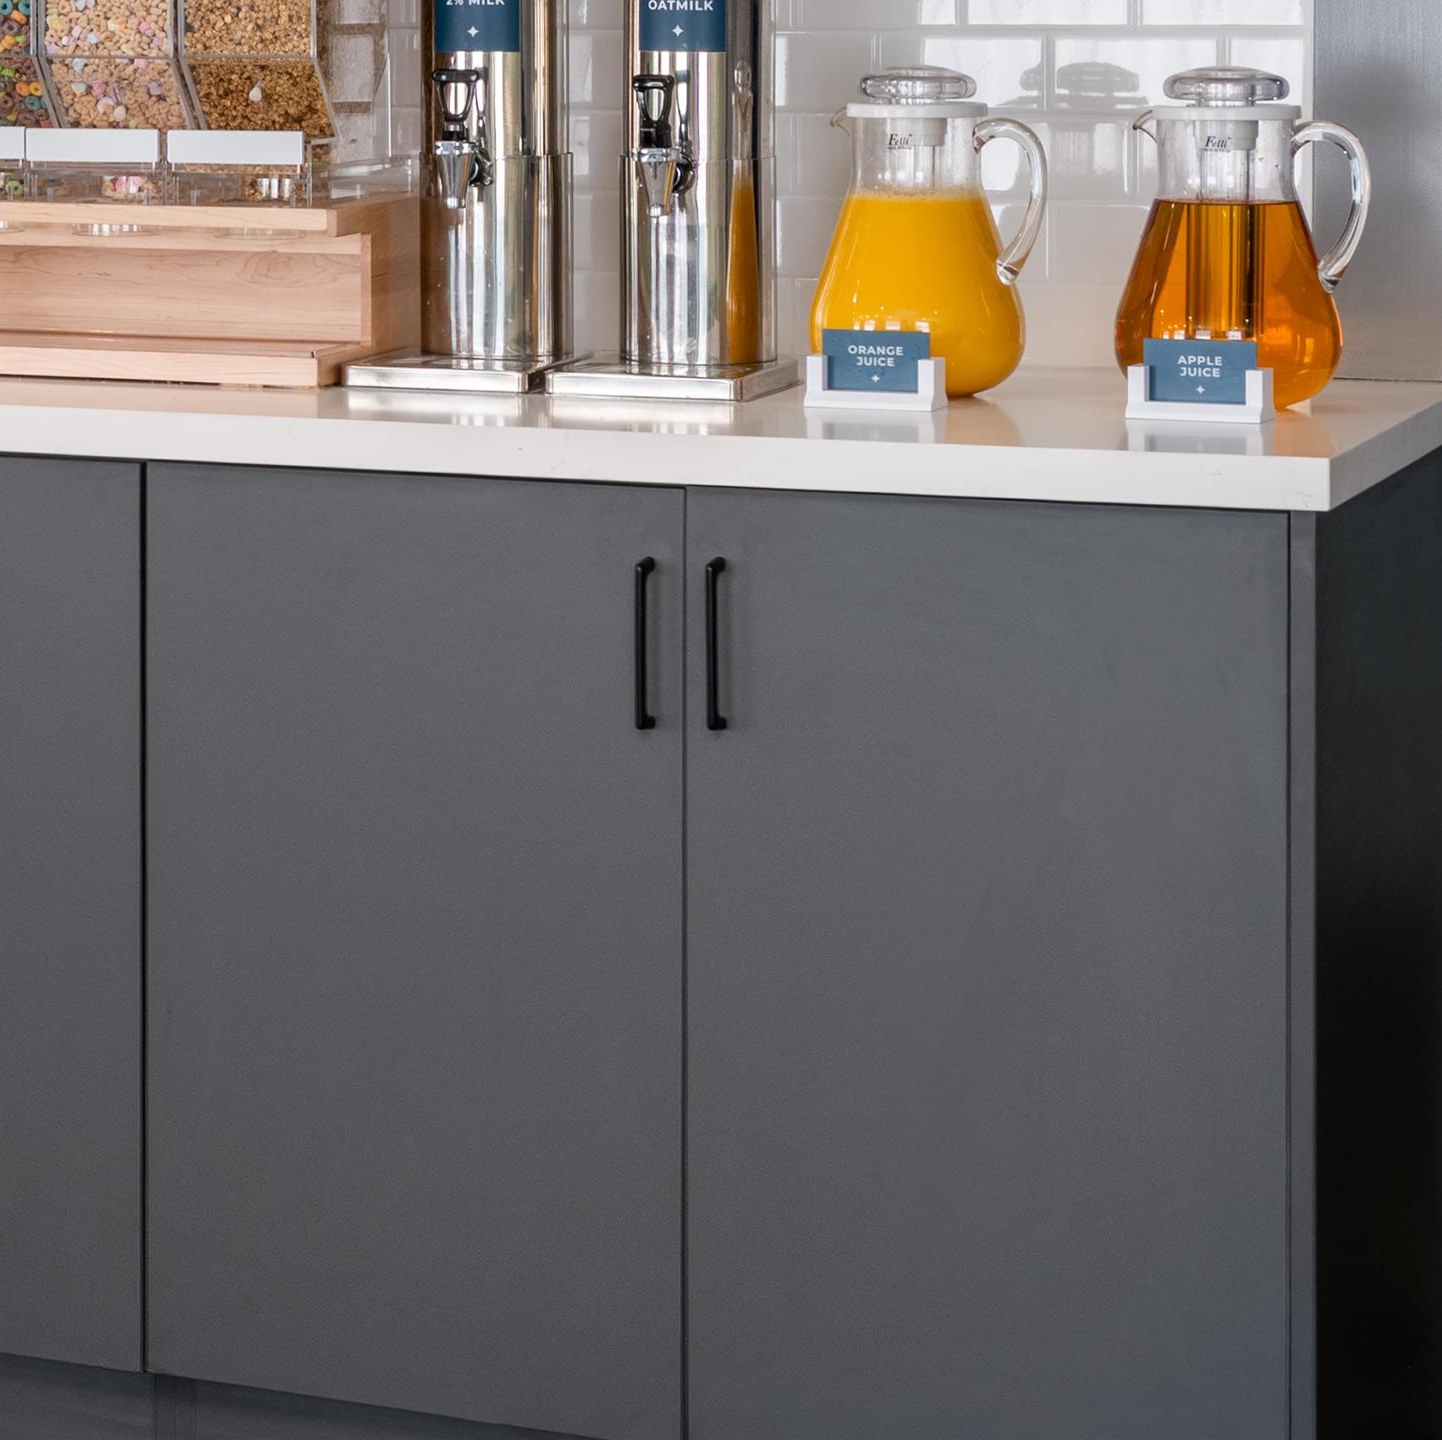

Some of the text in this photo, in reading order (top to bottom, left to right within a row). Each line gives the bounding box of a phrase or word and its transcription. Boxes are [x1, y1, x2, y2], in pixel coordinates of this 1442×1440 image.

[648, 0, 714, 11] OATMILK
[848, 345, 904, 356] ORANGE
[856, 356, 895, 367] JUICE
[1177, 355, 1223, 366] APPLE
[1180, 367, 1221, 377] JUICE
